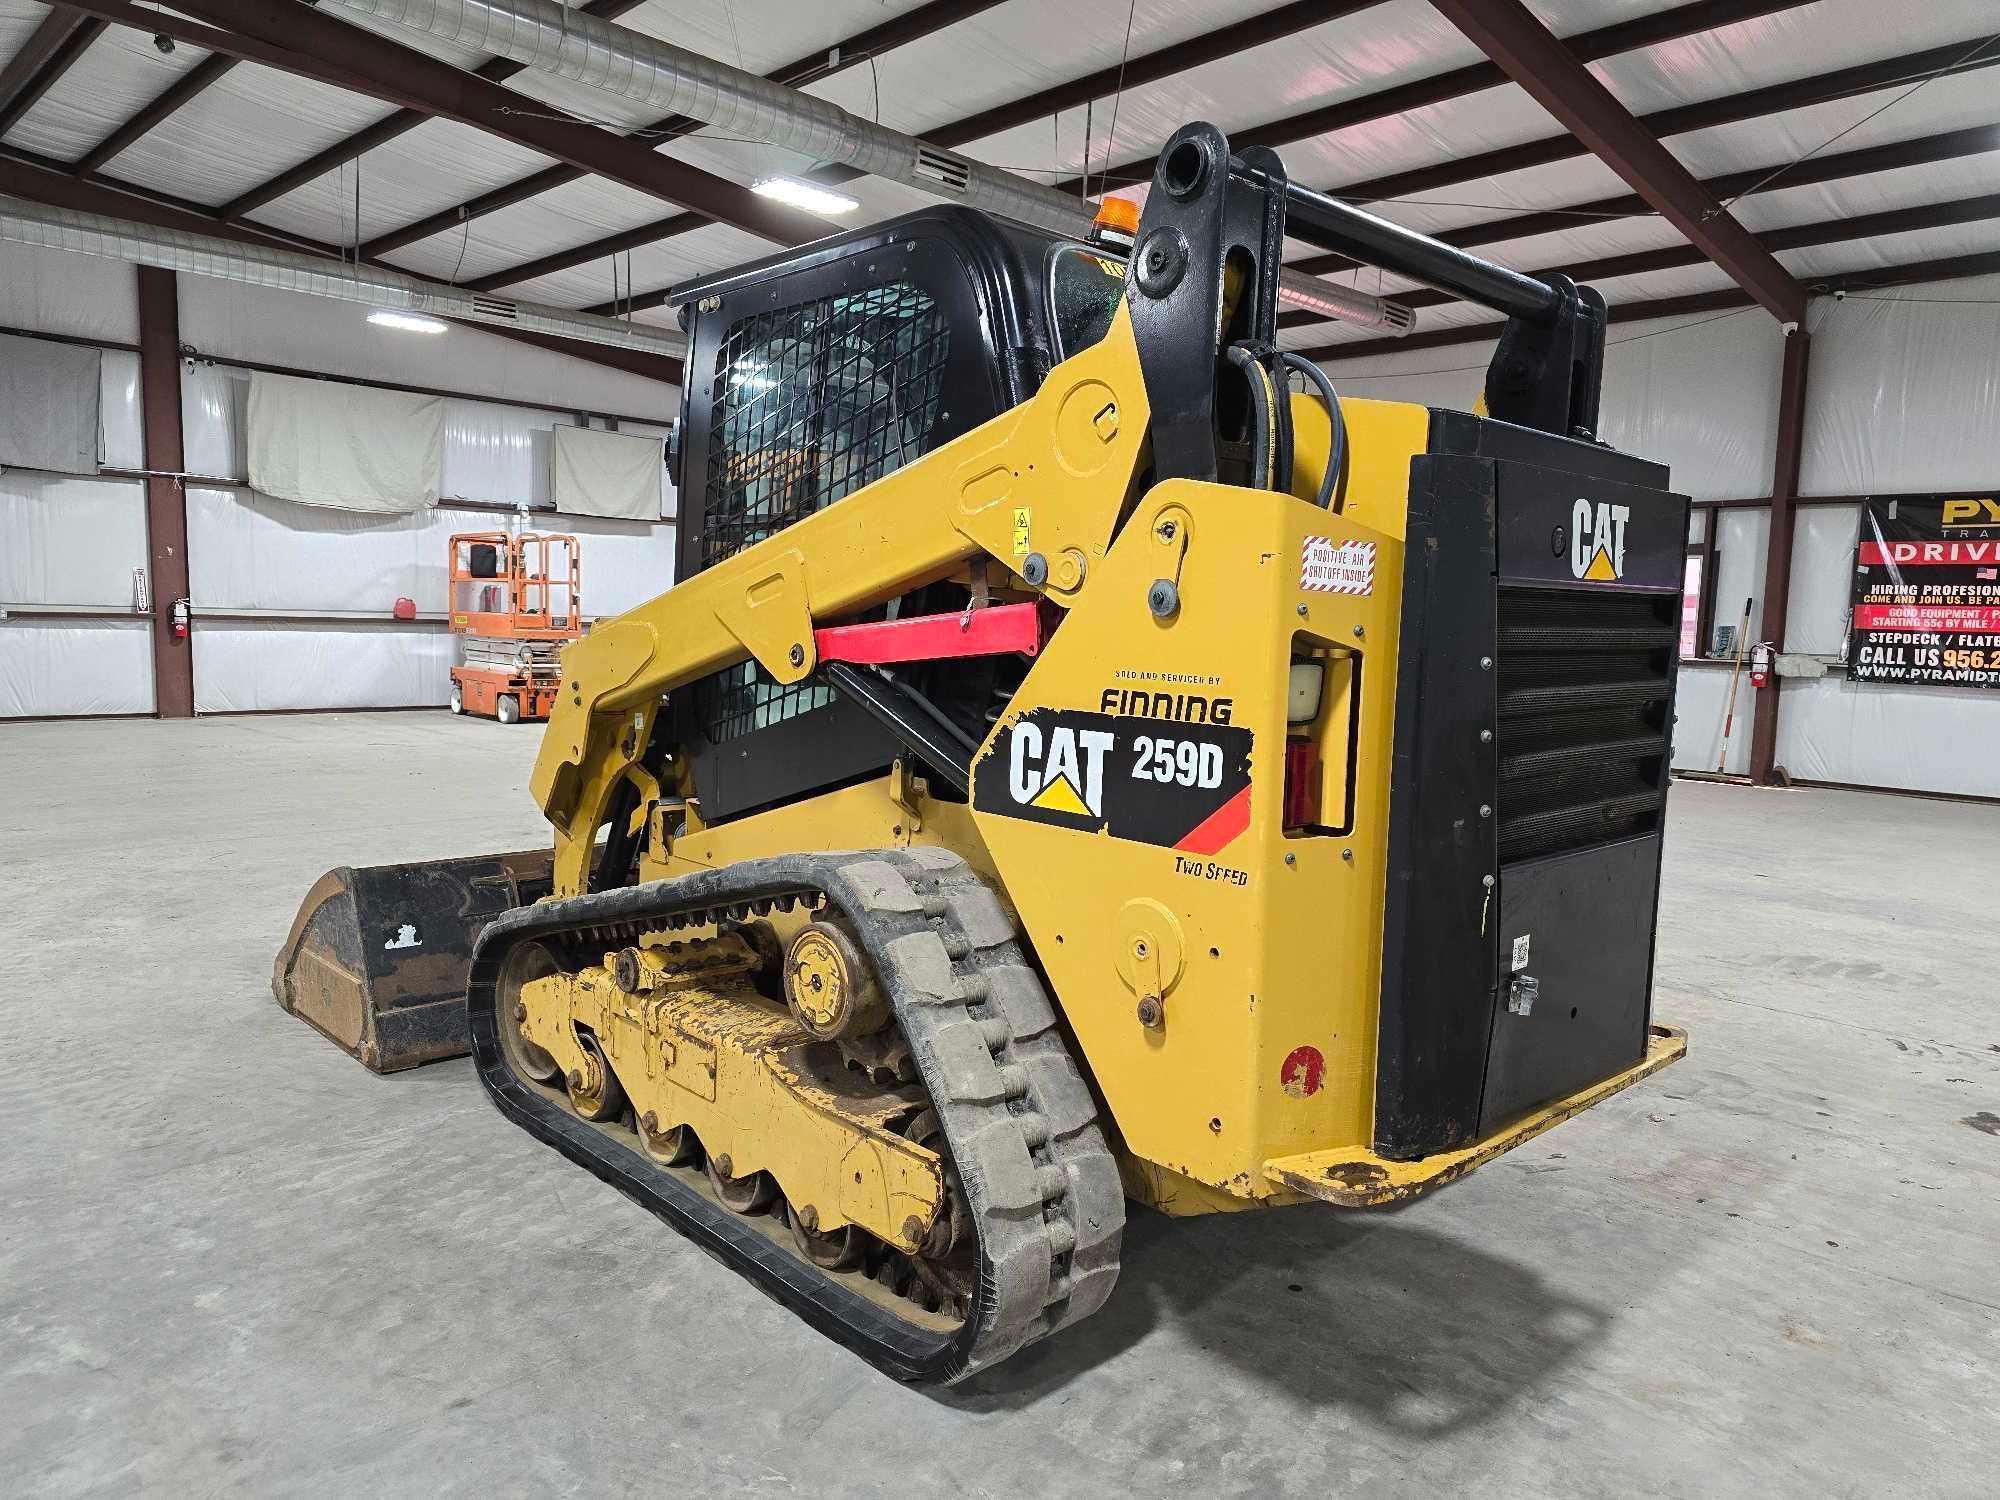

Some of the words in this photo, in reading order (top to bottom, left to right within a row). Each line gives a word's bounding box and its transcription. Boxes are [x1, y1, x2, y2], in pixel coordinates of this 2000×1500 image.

[1572, 498, 1629, 579] CAT
[1895, 543, 2000, 561] DRIV
[1342, 569, 1367, 583] INSIDE
[1871, 584, 1918, 595] HIRING
[1863, 595, 1891, 603] COME
[1893, 595, 1916, 604] AND
[1919, 596, 1942, 604] JOIN
[1947, 596, 1964, 604] US.
[1968, 597, 1982, 605] BE
[1888, 608, 1918, 618] GOOD
[1921, 609, 1981, 619] EQUIPMENT
[1872, 617, 1920, 627] STARTING
[1946, 619, 1960, 628] BY
[1963, 619, 1988, 629] MILE
[1869, 632, 1940, 645] STEPDECK
[1860, 646, 1906, 665] CALL
[1914, 648, 1940, 666] US
[1943, 649, 2000, 669] 956.2
[1140, 671, 1158, 680] AND
[1208, 676, 1220, 685] BY
[1856, 664, 2000, 683] WWW.PYRAMIDT
[1100, 688, 1233, 725] FINNING
[1009, 721, 1114, 817] CAT
[1132, 735, 1223, 789] 259D
